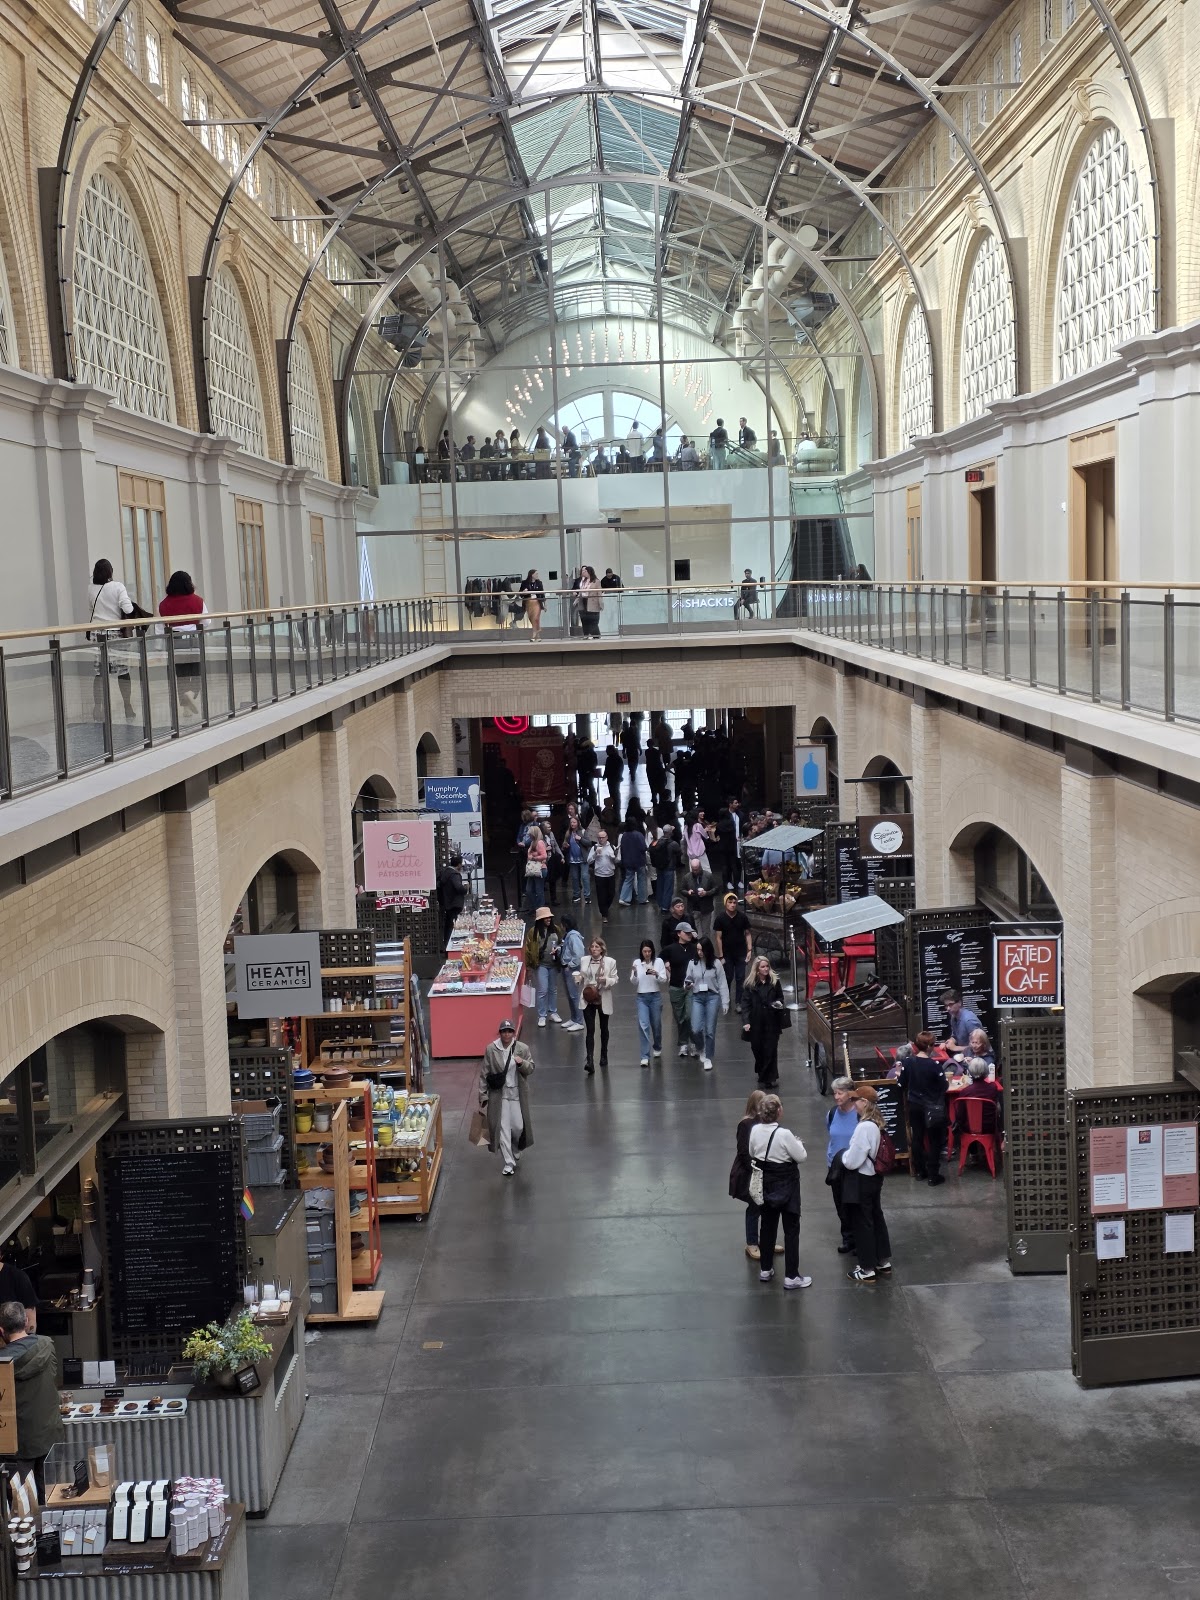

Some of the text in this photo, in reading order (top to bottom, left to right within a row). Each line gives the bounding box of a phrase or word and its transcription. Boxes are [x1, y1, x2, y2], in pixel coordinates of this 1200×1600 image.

[966, 472, 980, 482] EXIT
[685, 597, 734, 608] SHACK15
[427, 785, 459, 793] Humphry
[435, 792, 467, 800] Slocombe
[377, 854, 423, 869] miette
[1005, 944, 1052, 966] FATTED
[250, 965, 306, 979] HEATH
[251, 978, 307, 987] CERAMICS
[1005, 966, 1049, 992] CALF
